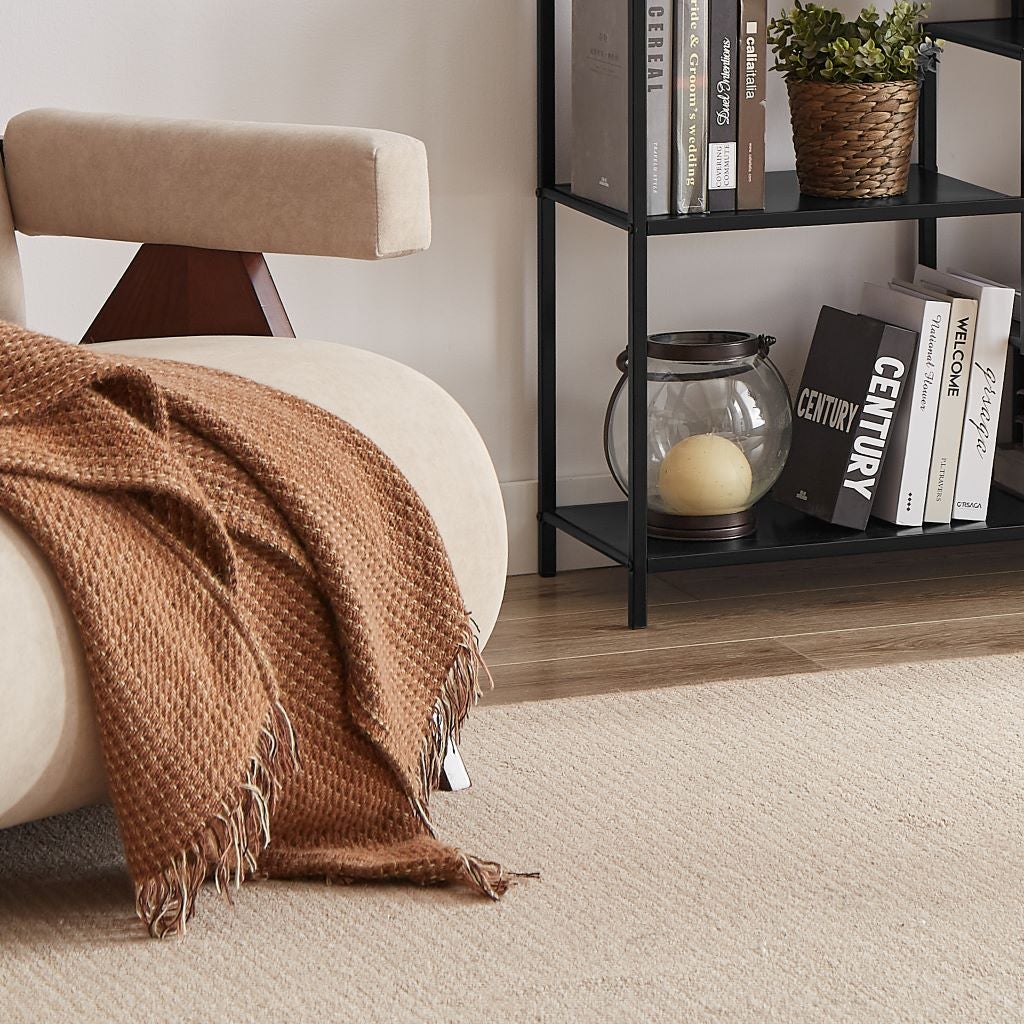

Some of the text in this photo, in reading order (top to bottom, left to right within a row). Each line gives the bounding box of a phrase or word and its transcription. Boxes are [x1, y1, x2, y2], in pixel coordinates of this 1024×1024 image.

[647, 5, 665, 93] CEREAL
[690, 34, 699, 48] &
[746, 36, 757, 99] caliaitalia
[688, 53, 699, 120] Groom's
[716, 36, 731, 125] Duel Intentions
[686, 125, 698, 186] wedding
[924, 314, 943, 370] National
[947, 316, 970, 398] WELCOME
[797, 387, 859, 434] CENTURY
[843, 356, 905, 500] CENTURY
[935, 469, 946, 503] TRAVERS
